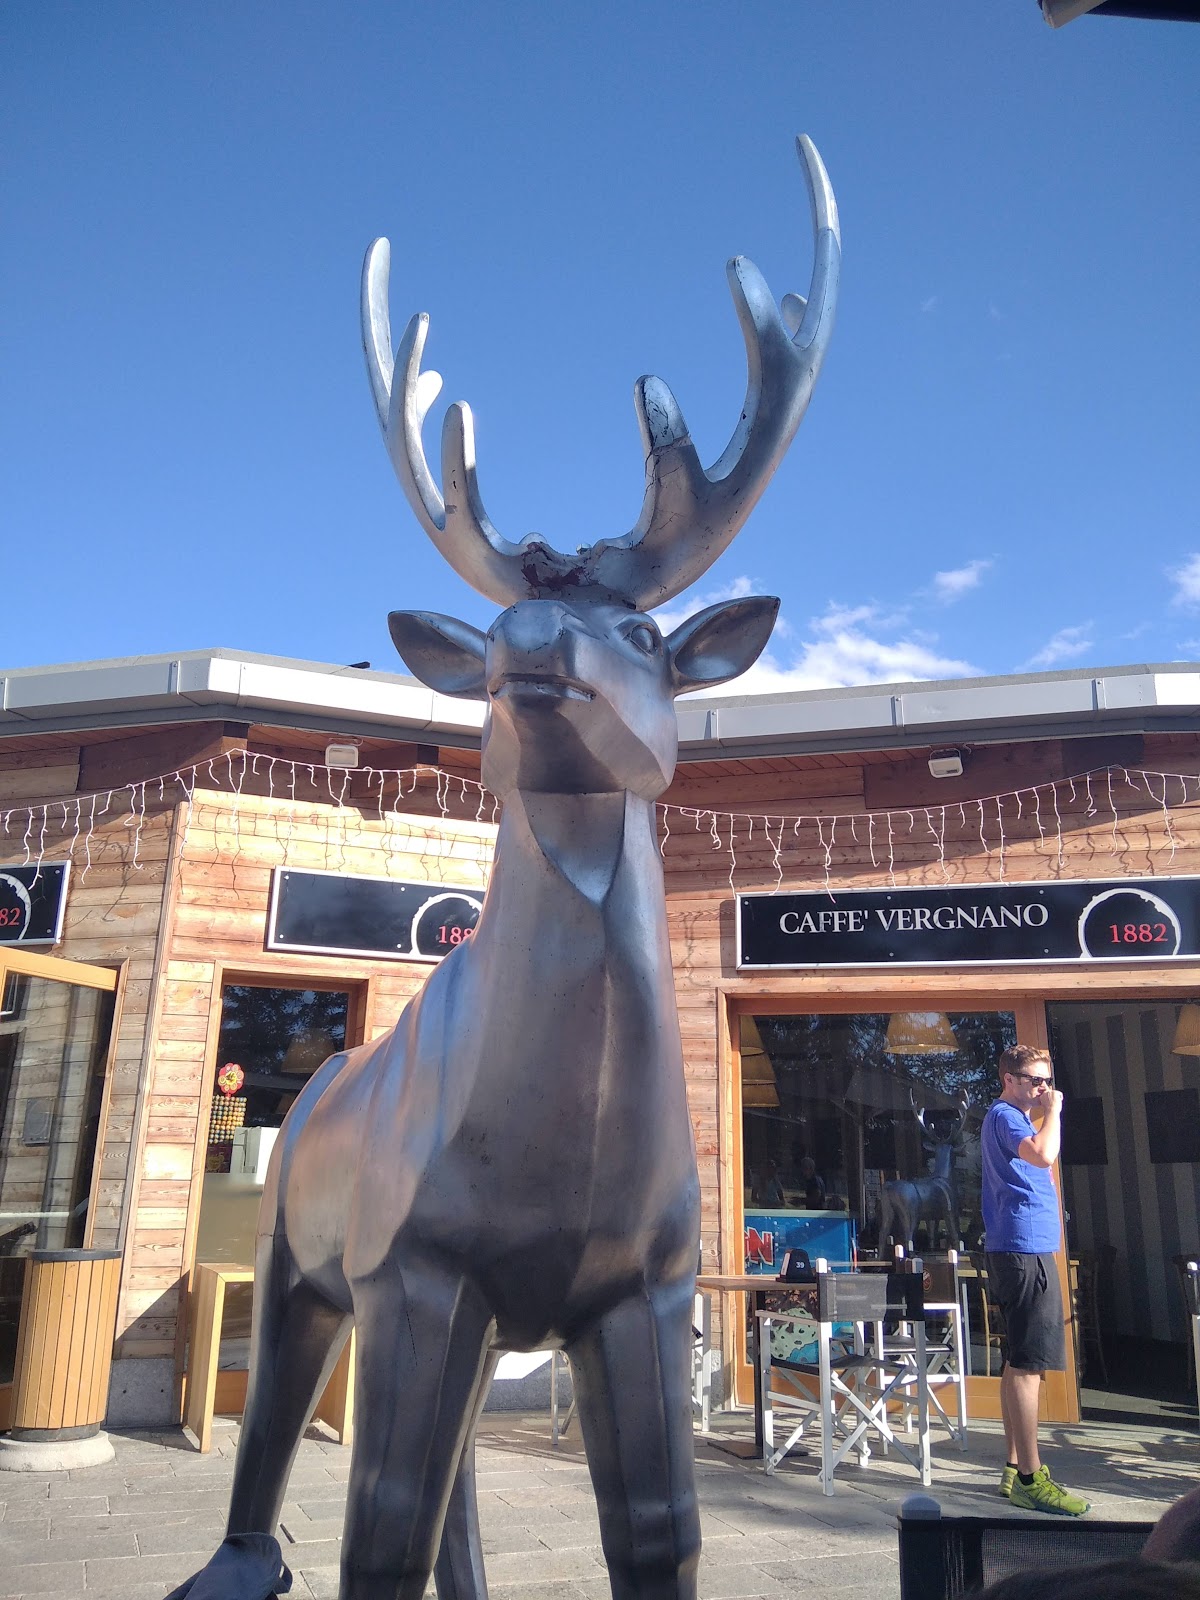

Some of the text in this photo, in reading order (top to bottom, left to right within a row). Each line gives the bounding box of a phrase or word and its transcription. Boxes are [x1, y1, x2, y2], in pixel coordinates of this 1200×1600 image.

[779, 903, 1049, 934] CAFFE' VERGNANO
[1109, 923, 1169, 943] 1882
